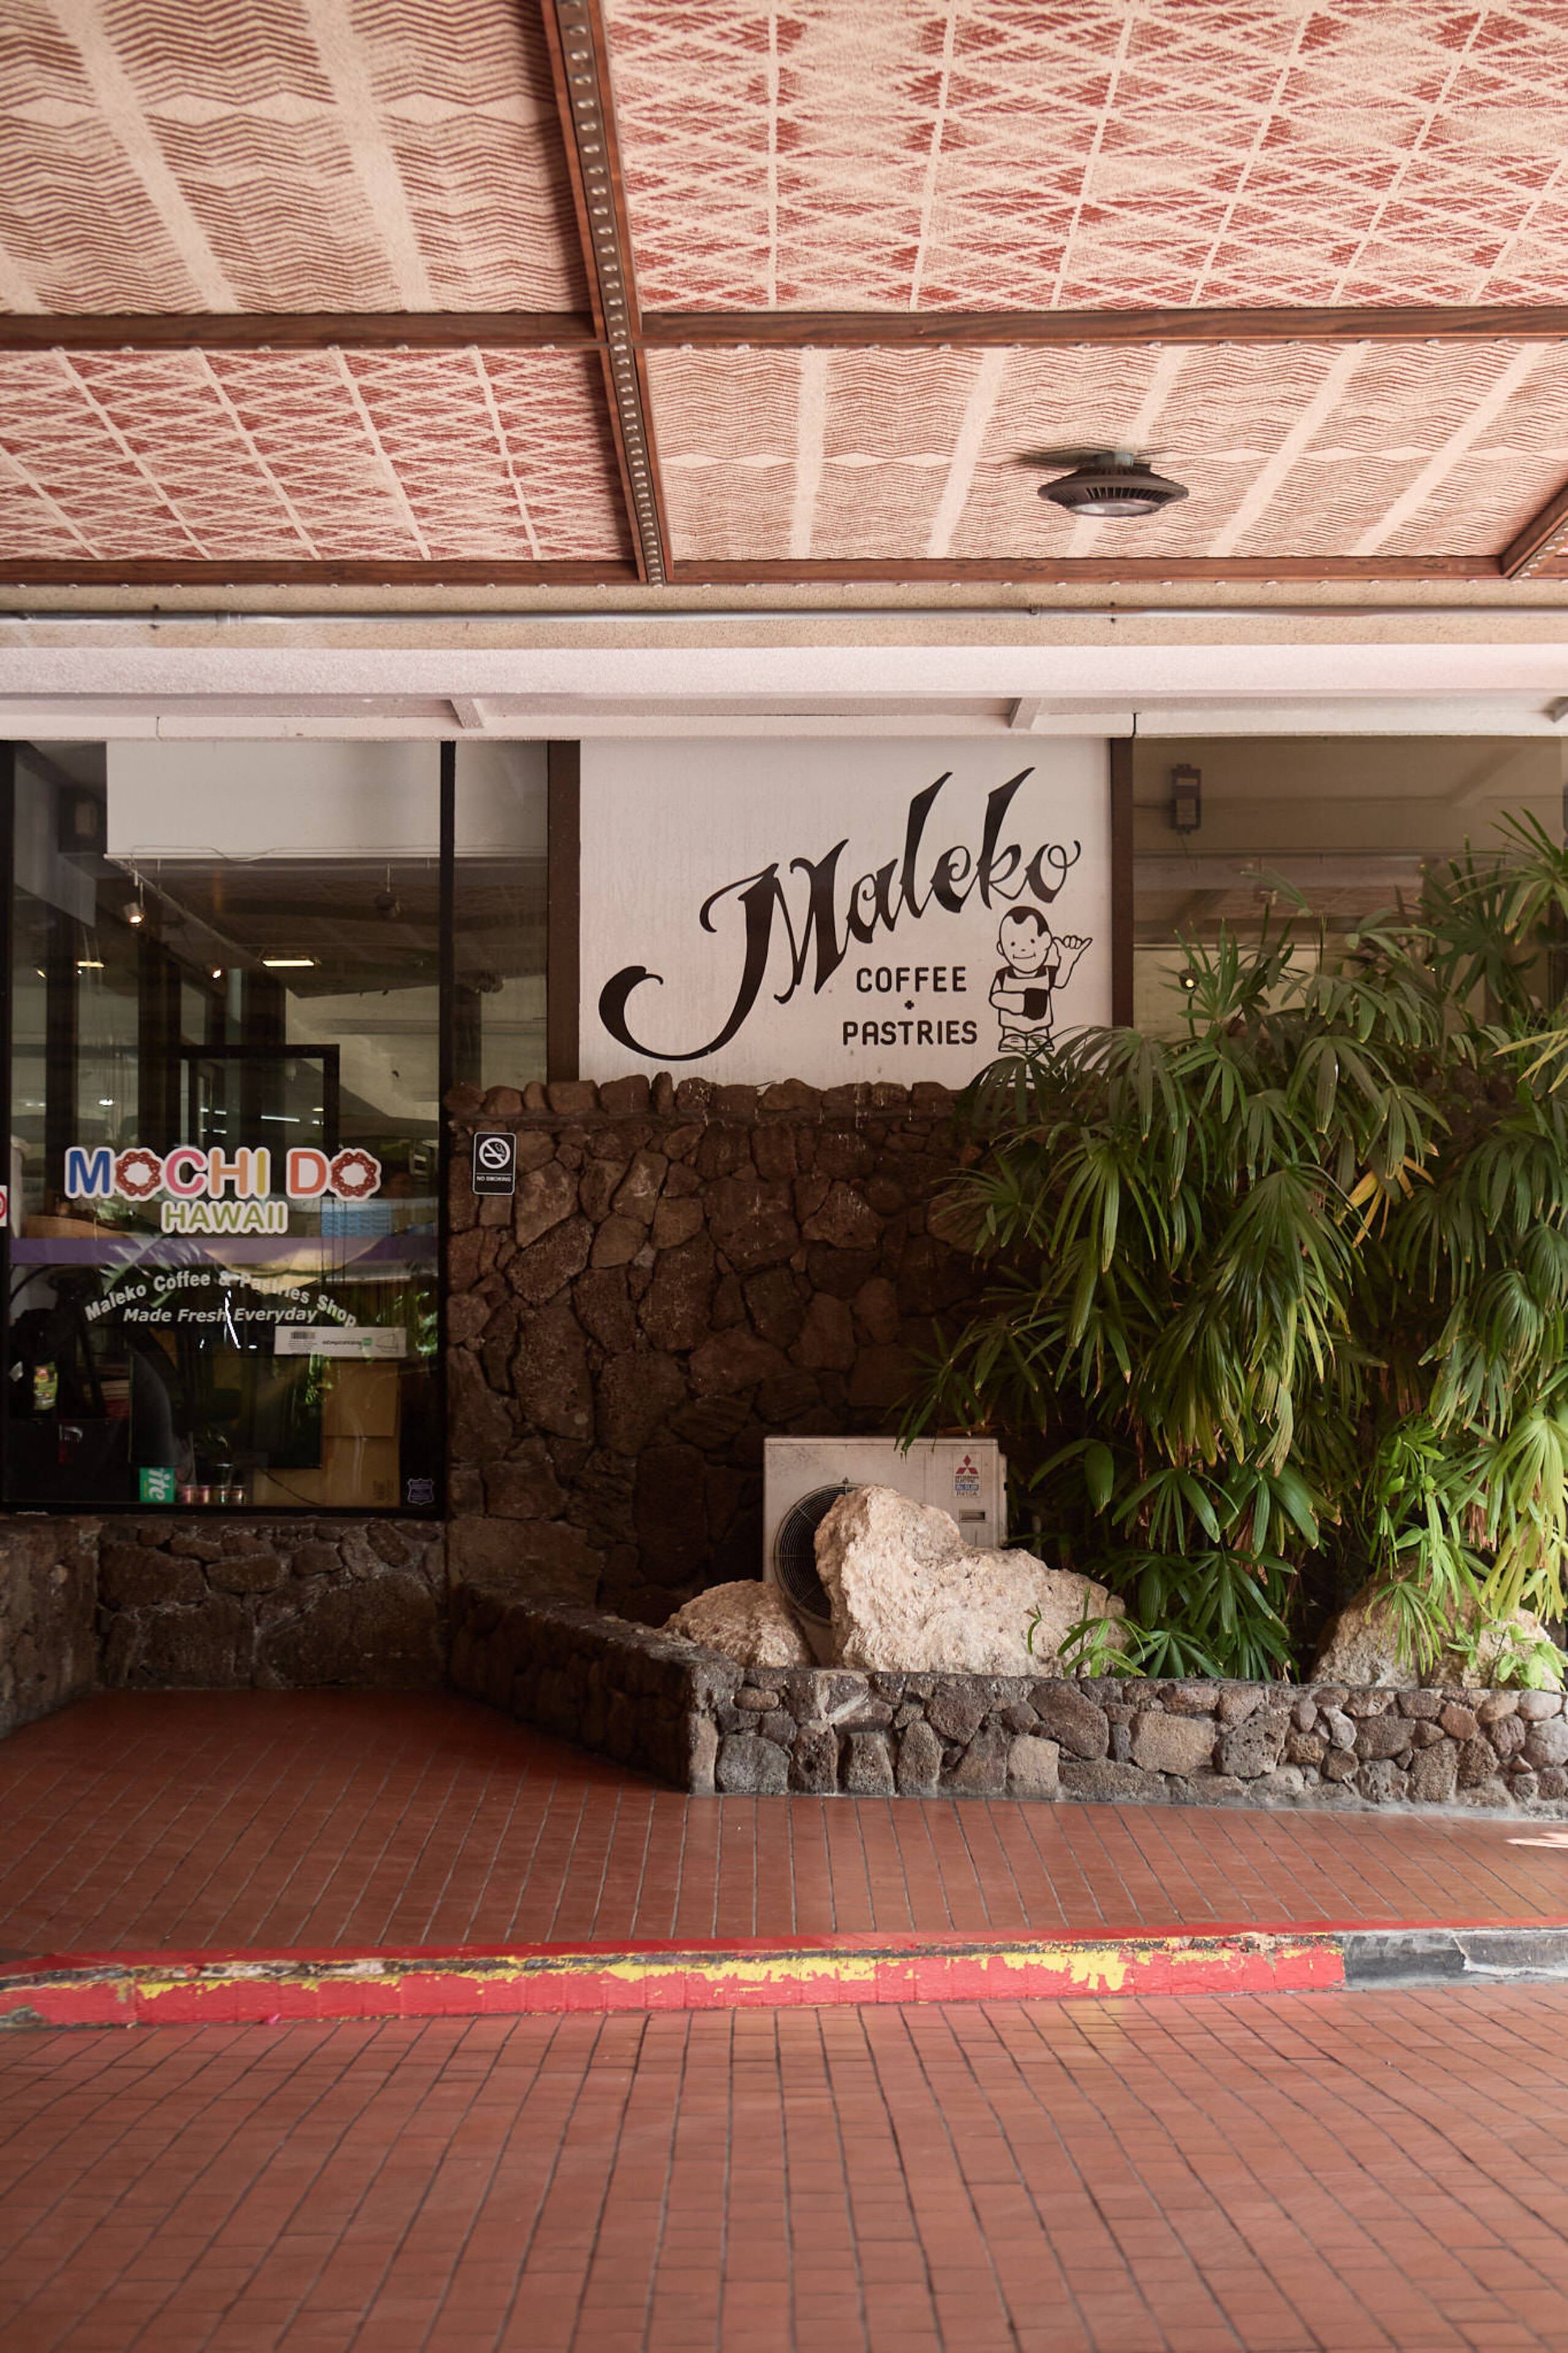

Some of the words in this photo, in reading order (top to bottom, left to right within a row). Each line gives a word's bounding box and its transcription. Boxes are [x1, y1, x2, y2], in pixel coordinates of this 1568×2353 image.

[599, 768, 1080, 1060] Maleko
[856, 966, 967, 992] COFFEE
[842, 1021, 978, 1045] PASTRIES
[66, 1147, 270, 1201] MOCHI
[286, 1147, 381, 1201] DO
[162, 1201, 288, 1234] HAWAII
[85, 1285, 146, 1321] Maleko
[154, 1271, 211, 1292] Coffee
[219, 1271, 230, 1286] &
[239, 1273, 310, 1304] Pastries
[317, 1294, 357, 1328] Shop
[123, 1309, 172, 1322] Made
[177, 1309, 227, 1322] Fresh
[234, 1307, 317, 1323] Everyday
